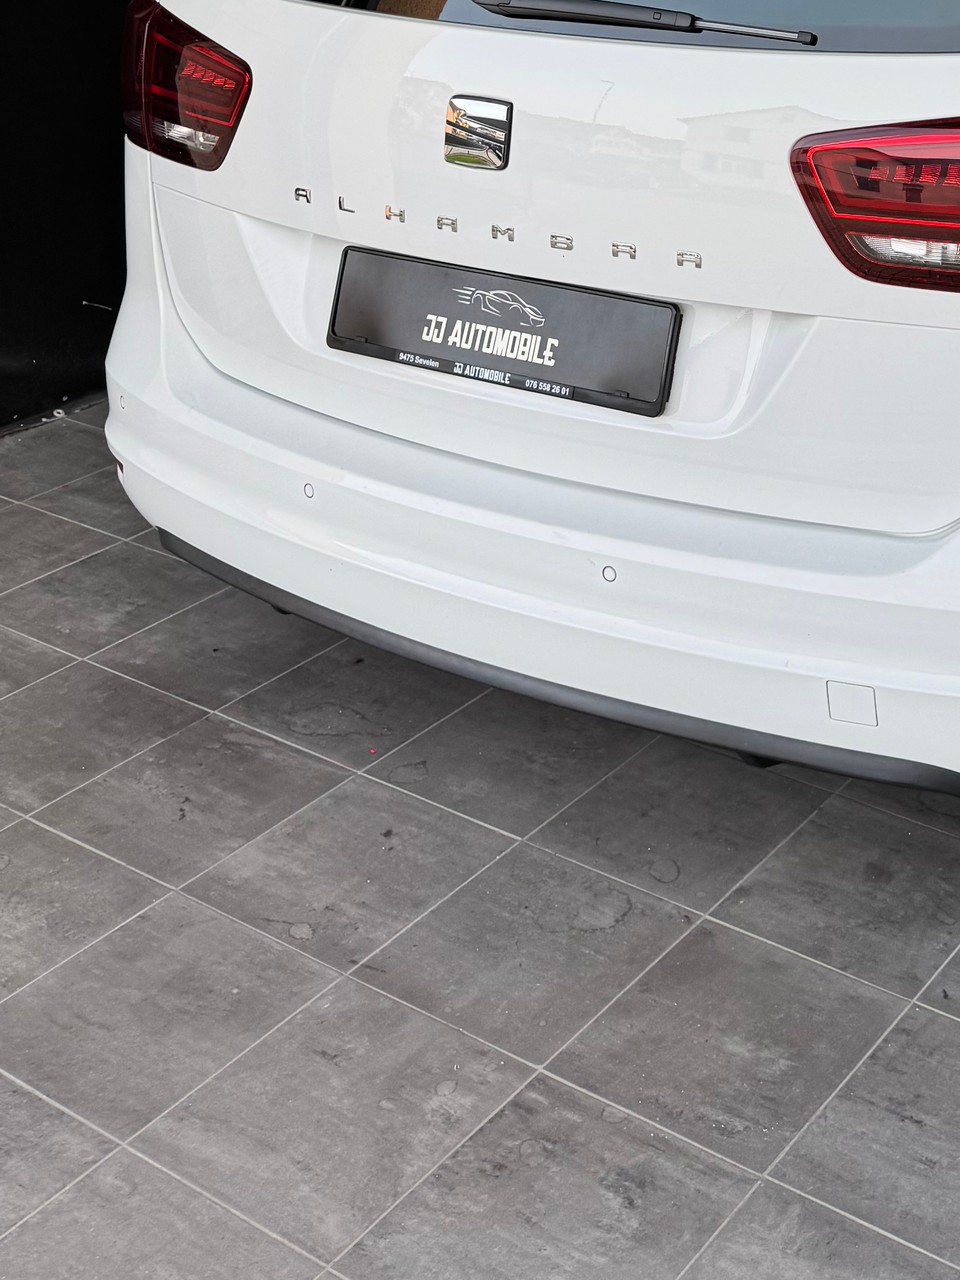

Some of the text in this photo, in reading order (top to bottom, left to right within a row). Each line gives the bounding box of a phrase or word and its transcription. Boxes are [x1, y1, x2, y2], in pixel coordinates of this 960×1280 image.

[294, 187, 702, 269] ALHAMBRA
[421, 314, 559, 367] JJ AUTOMOBILE
[399, 352, 440, 368] 9475 Sevelen
[453, 362, 511, 384] JJ AUTOMOBILE
[525, 379, 570, 396] 076 558 26 01
